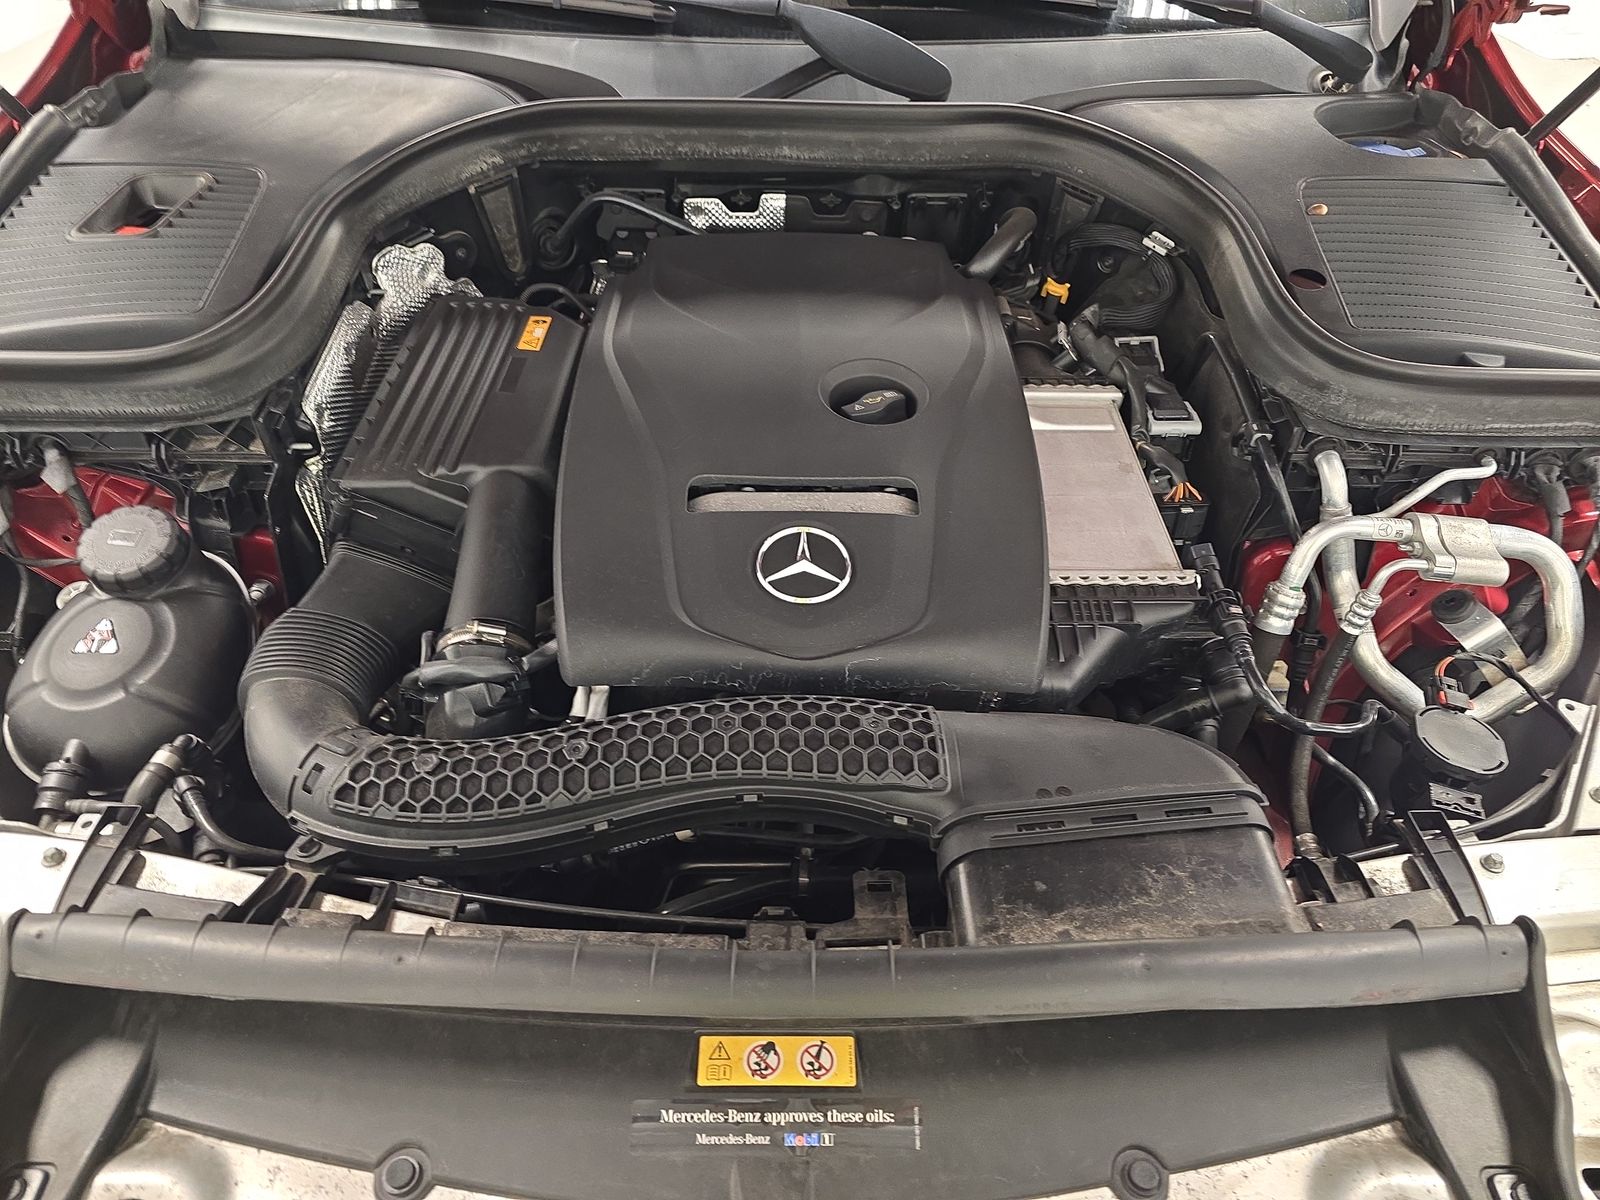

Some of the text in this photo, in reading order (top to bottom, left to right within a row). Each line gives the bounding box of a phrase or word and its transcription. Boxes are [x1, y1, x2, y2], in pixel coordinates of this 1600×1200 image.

[660, 1109, 895, 1126] Mercedes-Benz approves these oils:
[695, 1133, 771, 1145] Mercedes-Benz
